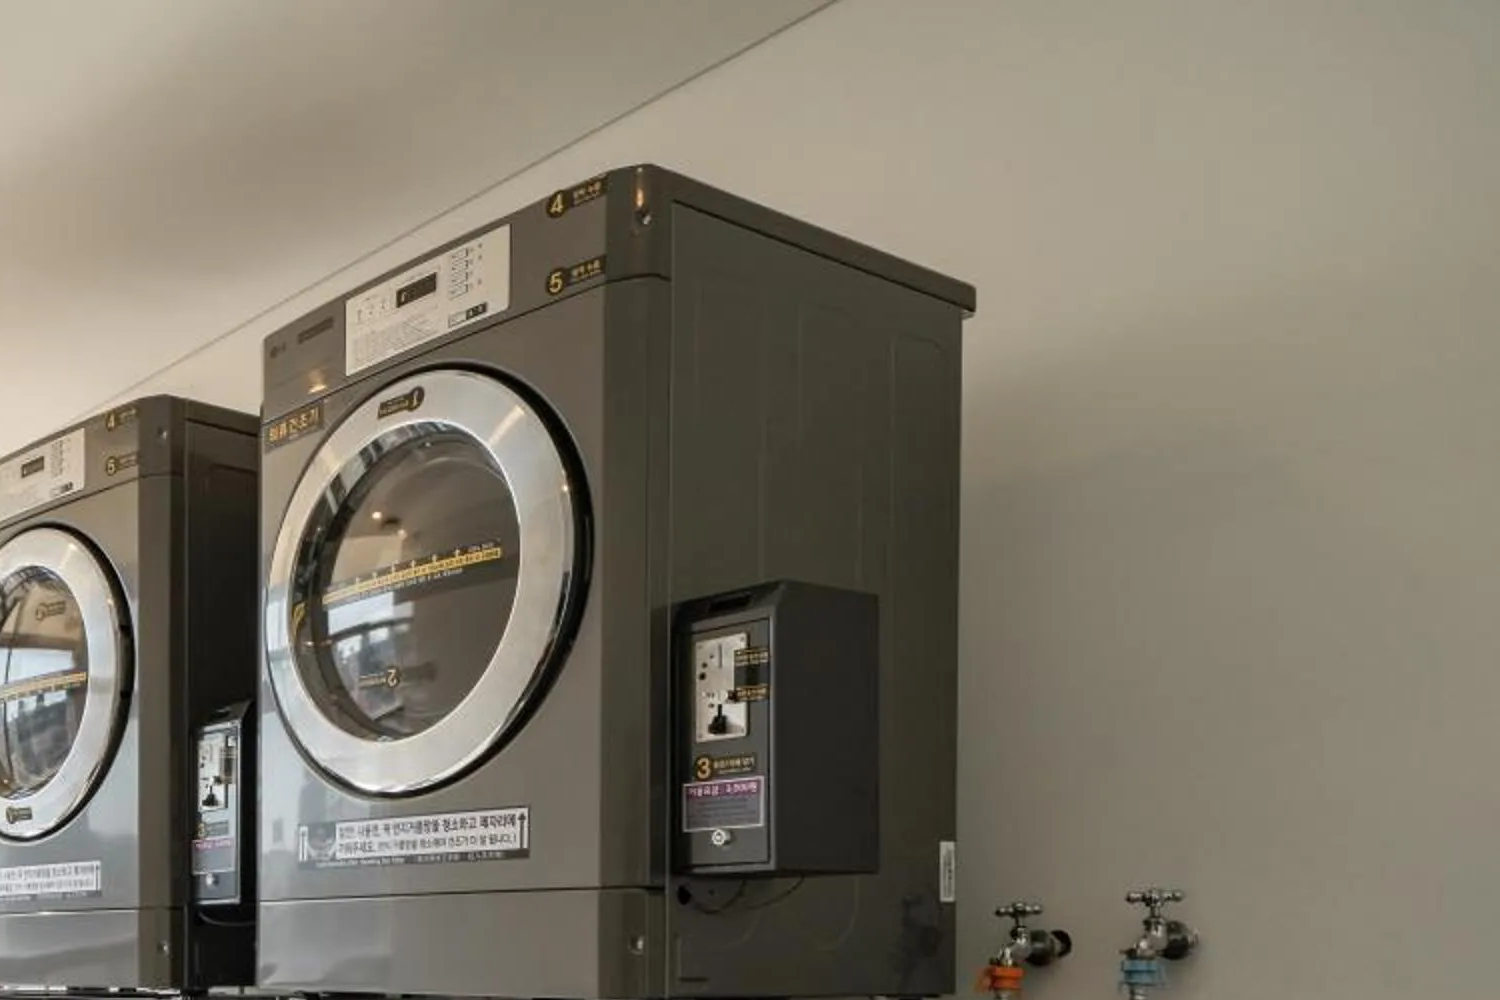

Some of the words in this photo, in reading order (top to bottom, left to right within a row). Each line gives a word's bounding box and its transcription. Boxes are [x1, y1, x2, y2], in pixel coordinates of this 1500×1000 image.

[549, 193, 564, 214] 4
[548, 271, 563, 293] 5
[697, 757, 711, 780] 3
